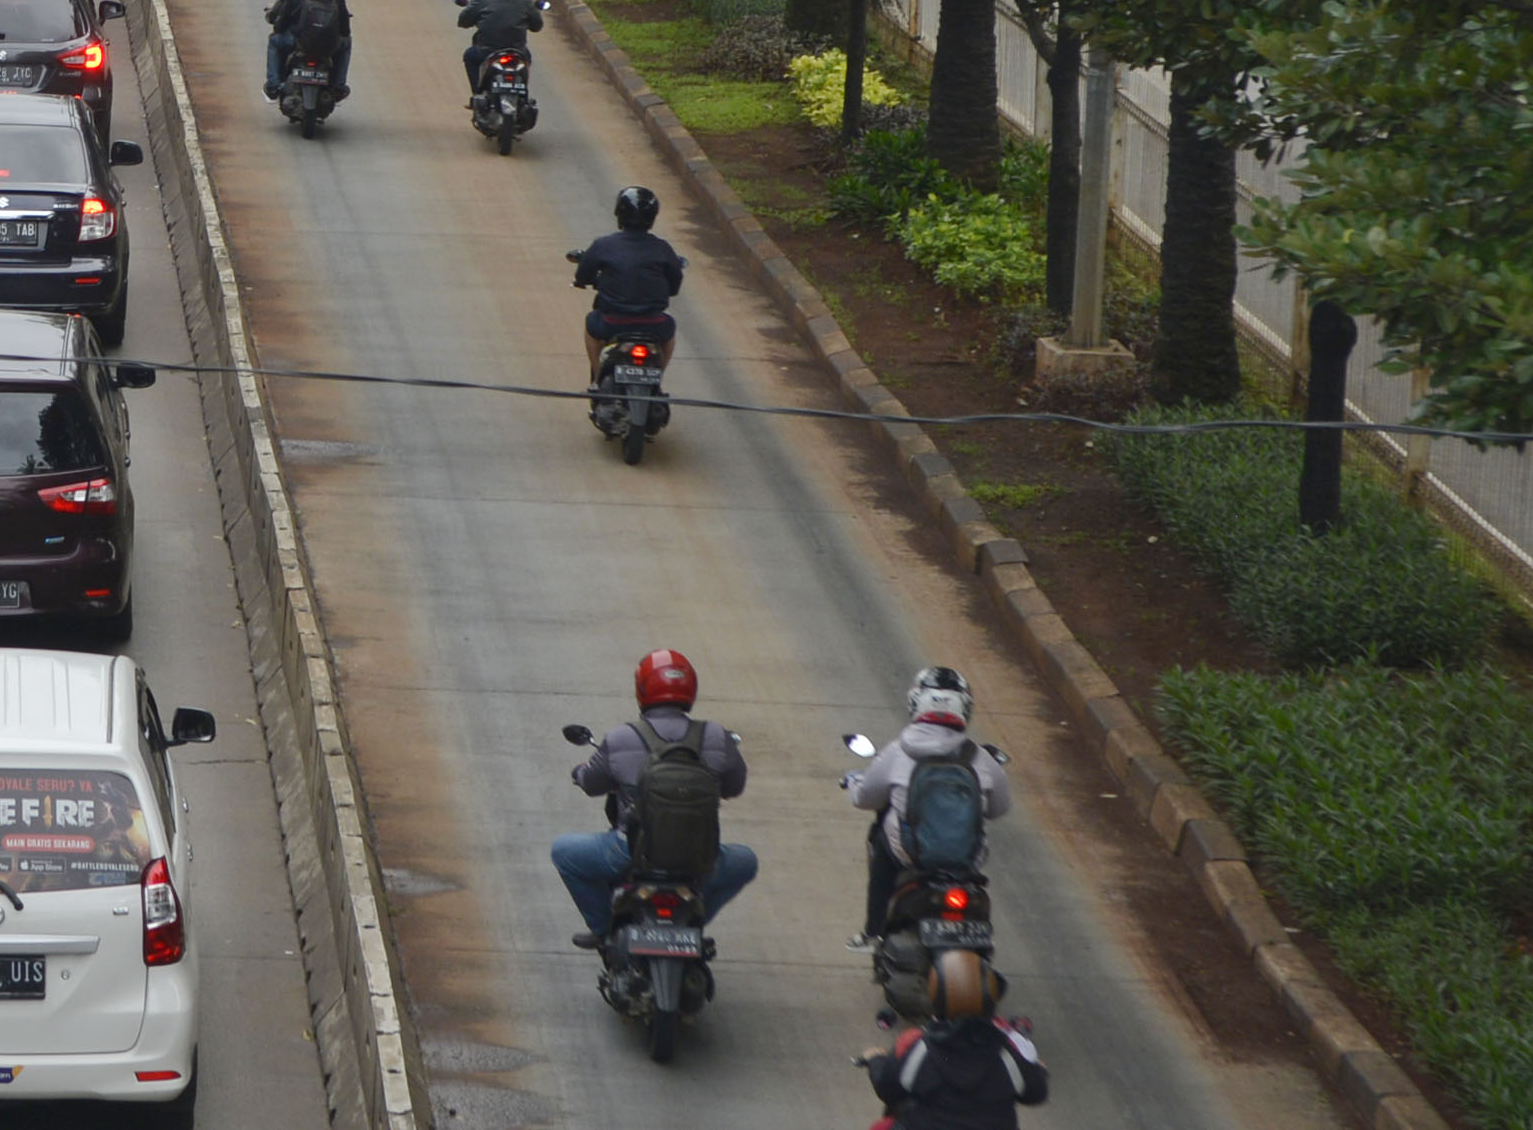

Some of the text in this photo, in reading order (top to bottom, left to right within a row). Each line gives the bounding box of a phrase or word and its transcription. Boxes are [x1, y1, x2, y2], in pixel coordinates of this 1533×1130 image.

[16, 223, 35, 237] TAB
[37, 778, 75, 792] SERU?
[79, 779, 93, 793] YA
[6, 837, 91, 849] MAIN GRATIS SEKARANG
[11, 961, 43, 982] UIS
